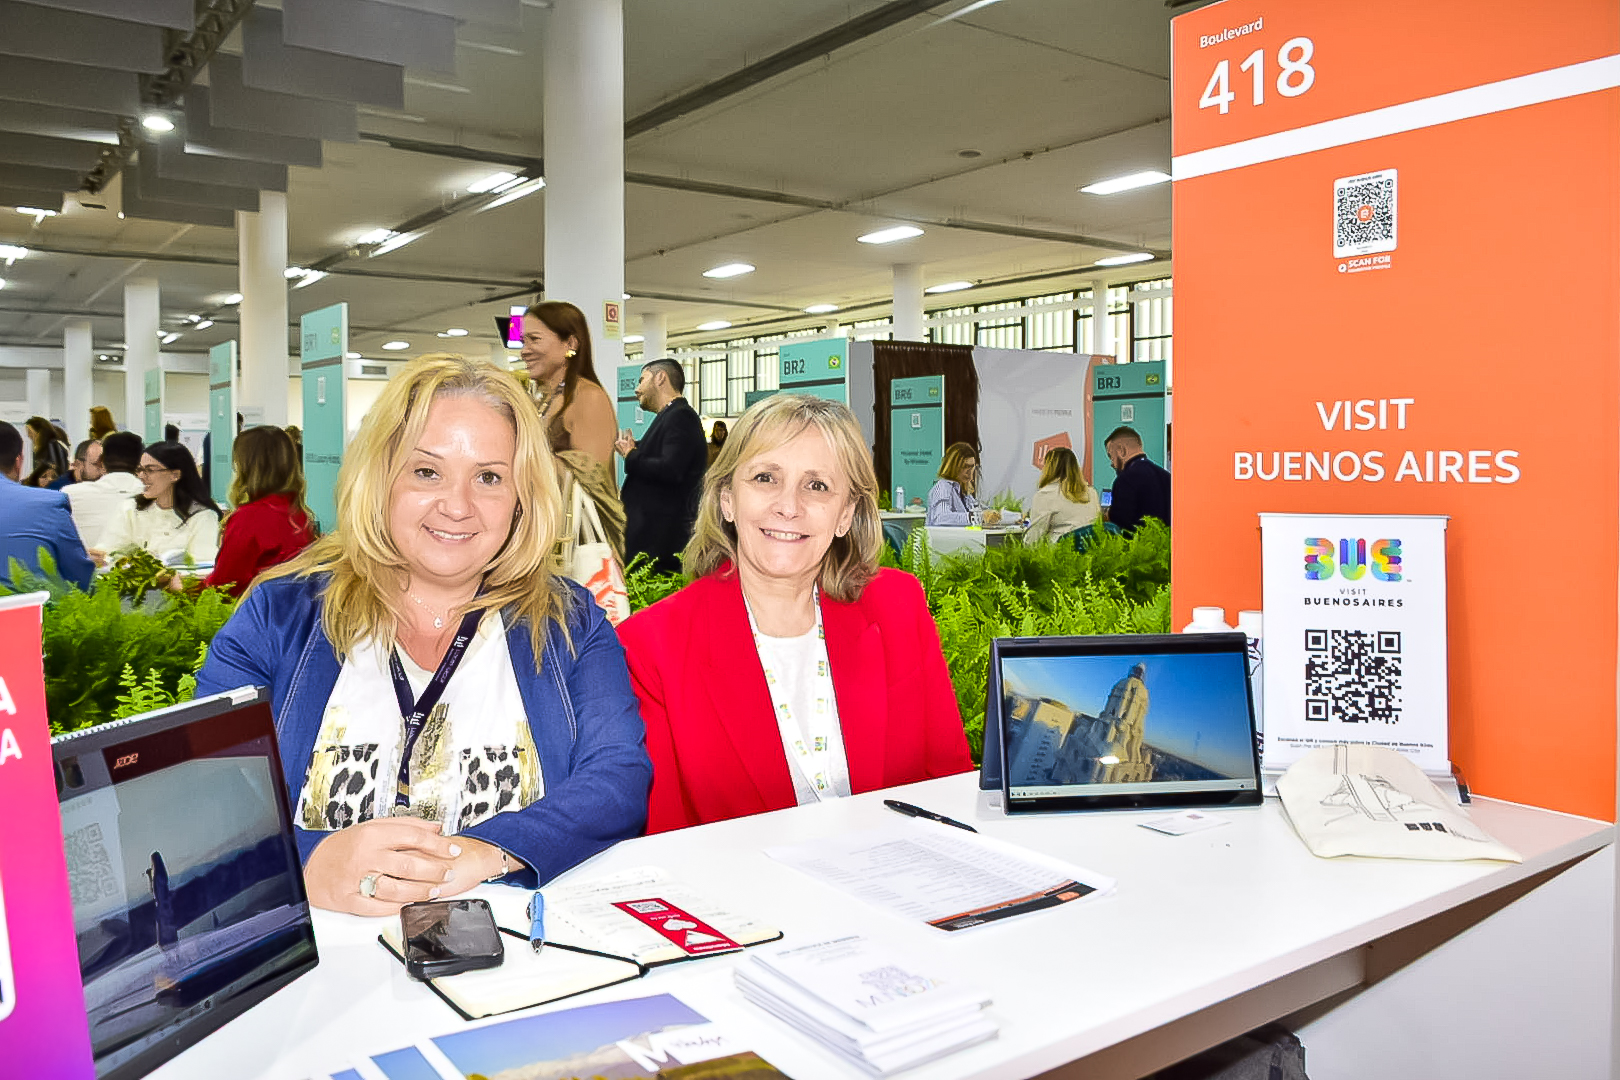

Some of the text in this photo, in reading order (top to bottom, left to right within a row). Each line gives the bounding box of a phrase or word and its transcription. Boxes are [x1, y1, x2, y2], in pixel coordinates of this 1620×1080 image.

[1199, 16, 1263, 49] Boulevard
[1198, 36, 1316, 115] 418
[1348, 257, 1372, 268] SCAN
[783, 358, 805, 376] BR2
[1097, 376, 1121, 390] BR3
[1316, 398, 1415, 431] VISIT
[1234, 450, 1521, 484] BUENOS AIRES
[1304, 537, 1403, 582] BUE
[1304, 597, 1404, 607] BUENOSAIRES
